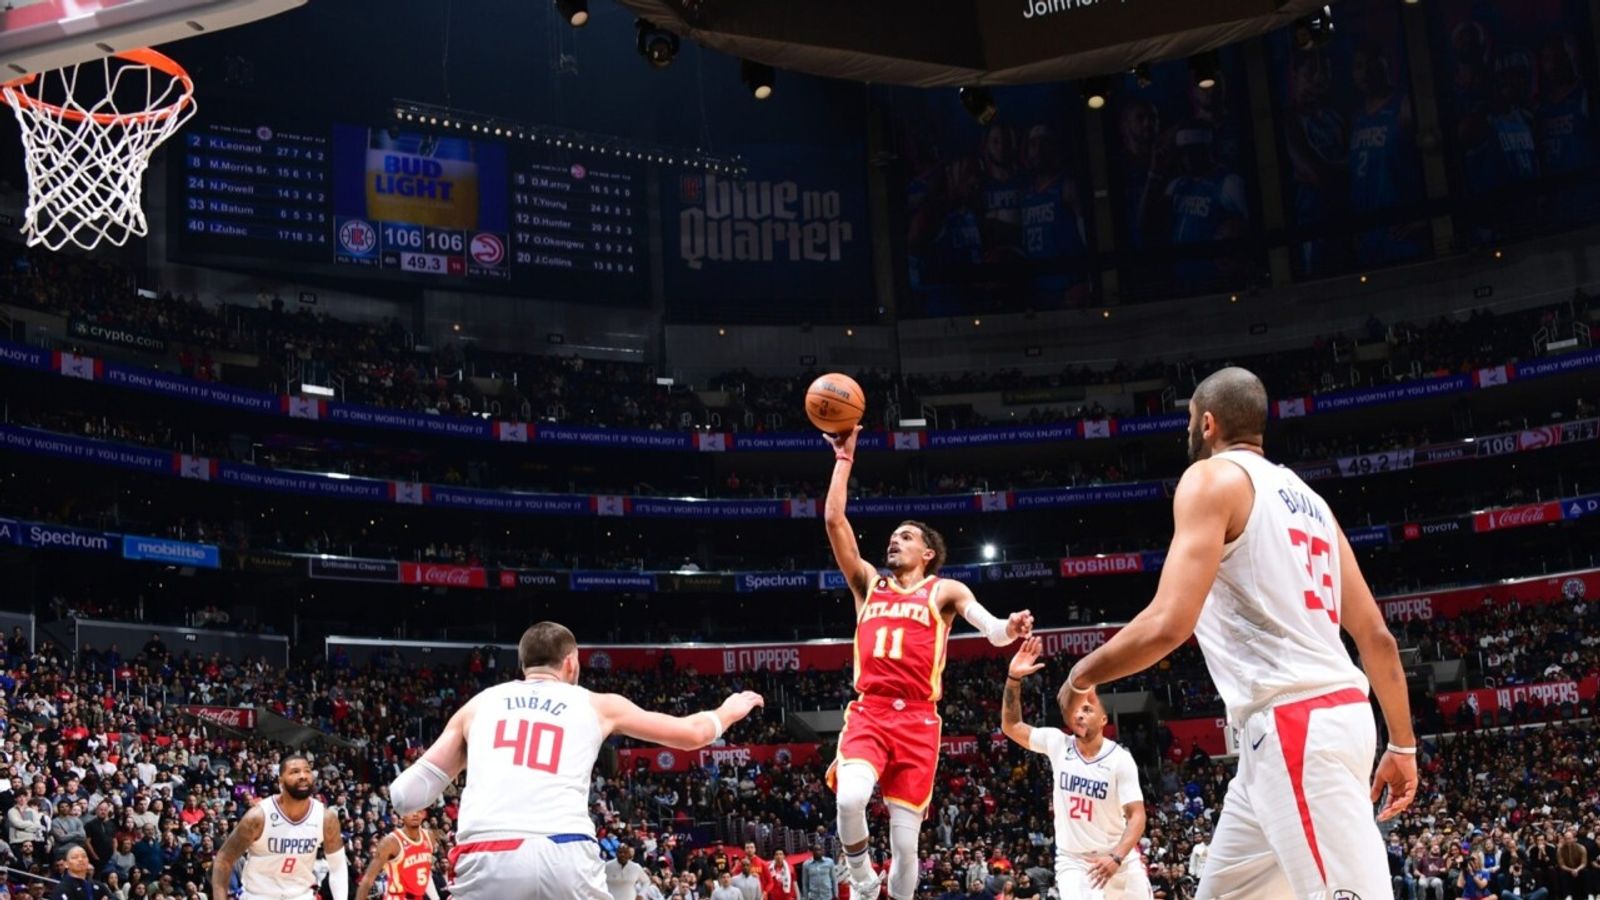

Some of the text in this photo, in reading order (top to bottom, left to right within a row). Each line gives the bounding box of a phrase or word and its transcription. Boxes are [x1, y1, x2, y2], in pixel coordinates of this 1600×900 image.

[192, 136, 200, 147] 2
[210, 139, 262, 153] K.Leonard
[192, 158, 200, 168] 8
[210, 160, 254, 174] M.Morris
[384, 155, 443, 178] BUD
[189, 177, 205, 189] 24
[210, 182, 254, 194] N.Powell
[376, 175, 454, 200] LIGHT
[189, 198, 254, 215] 33 N.Batum
[803, 190, 840, 220] no
[189, 220, 205, 231] 40
[385, 228, 463, 251] 106 106
[680, 207, 853, 269] Quarter
[407, 254, 441, 270] 49.3
[90, 326, 165, 350] crypto.com
[0, 349, 40, 364] NJOY IT
[109, 370, 271, 409] IT'S ONLY WORTH IT IF YOU ENJOY IT
[1317, 400, 1332, 409] IT'S
[1333, 397, 1354, 407] ONLY
[1355, 391, 1387, 404] WORTH
[1407, 386, 1424, 396] YOU
[1426, 381, 1454, 393] ENJOY
[332, 409, 348, 419] IT'S
[350, 411, 372, 422] ONLY
[374, 414, 406, 425] WORTH
[428, 419, 445, 429] YOU
[446, 422, 473, 433] ENJOY
[8, 434, 163, 467] ONLY WORTH IT IF YOU ENJOY IT
[1482, 436, 1514, 454] 106
[1427, 448, 1463, 461] Hawks
[1348, 455, 1388, 475] 49.2
[1499, 508, 1544, 524] Coca-Cola
[1349, 531, 1384, 542] EXPRESS
[1423, 522, 1459, 534] TOYOTA
[30, 525, 108, 550] Spectrum
[137, 542, 206, 560] mobilitie
[359, 562, 386, 572] Church
[1064, 557, 1138, 573] TOSHIBA
[425, 567, 470, 585] Coca-Cola
[518, 575, 556, 585] TOYOTA
[577, 577, 650, 586] AMERICAN EXPRESS
[745, 574, 807, 590] Spectrum
[828, 575, 846, 586] UCL
[1288, 528, 1339, 625] 33
[863, 602, 930, 626] ATLANTA
[1384, 597, 1433, 623] IPPERS
[873, 627, 904, 659] 11
[1513, 681, 1580, 709] CIPPERS
[504, 696, 568, 716] ZUBAC
[493, 719, 564, 775] 40
[1060, 771, 1109, 800] CLIPPERS
[1069, 796, 1093, 822] 24
[268, 837, 317, 854] CLIPPERS
[281, 858, 296, 874] 8
[403, 852, 432, 868] ATLANT
[416, 867, 427, 886] 5
